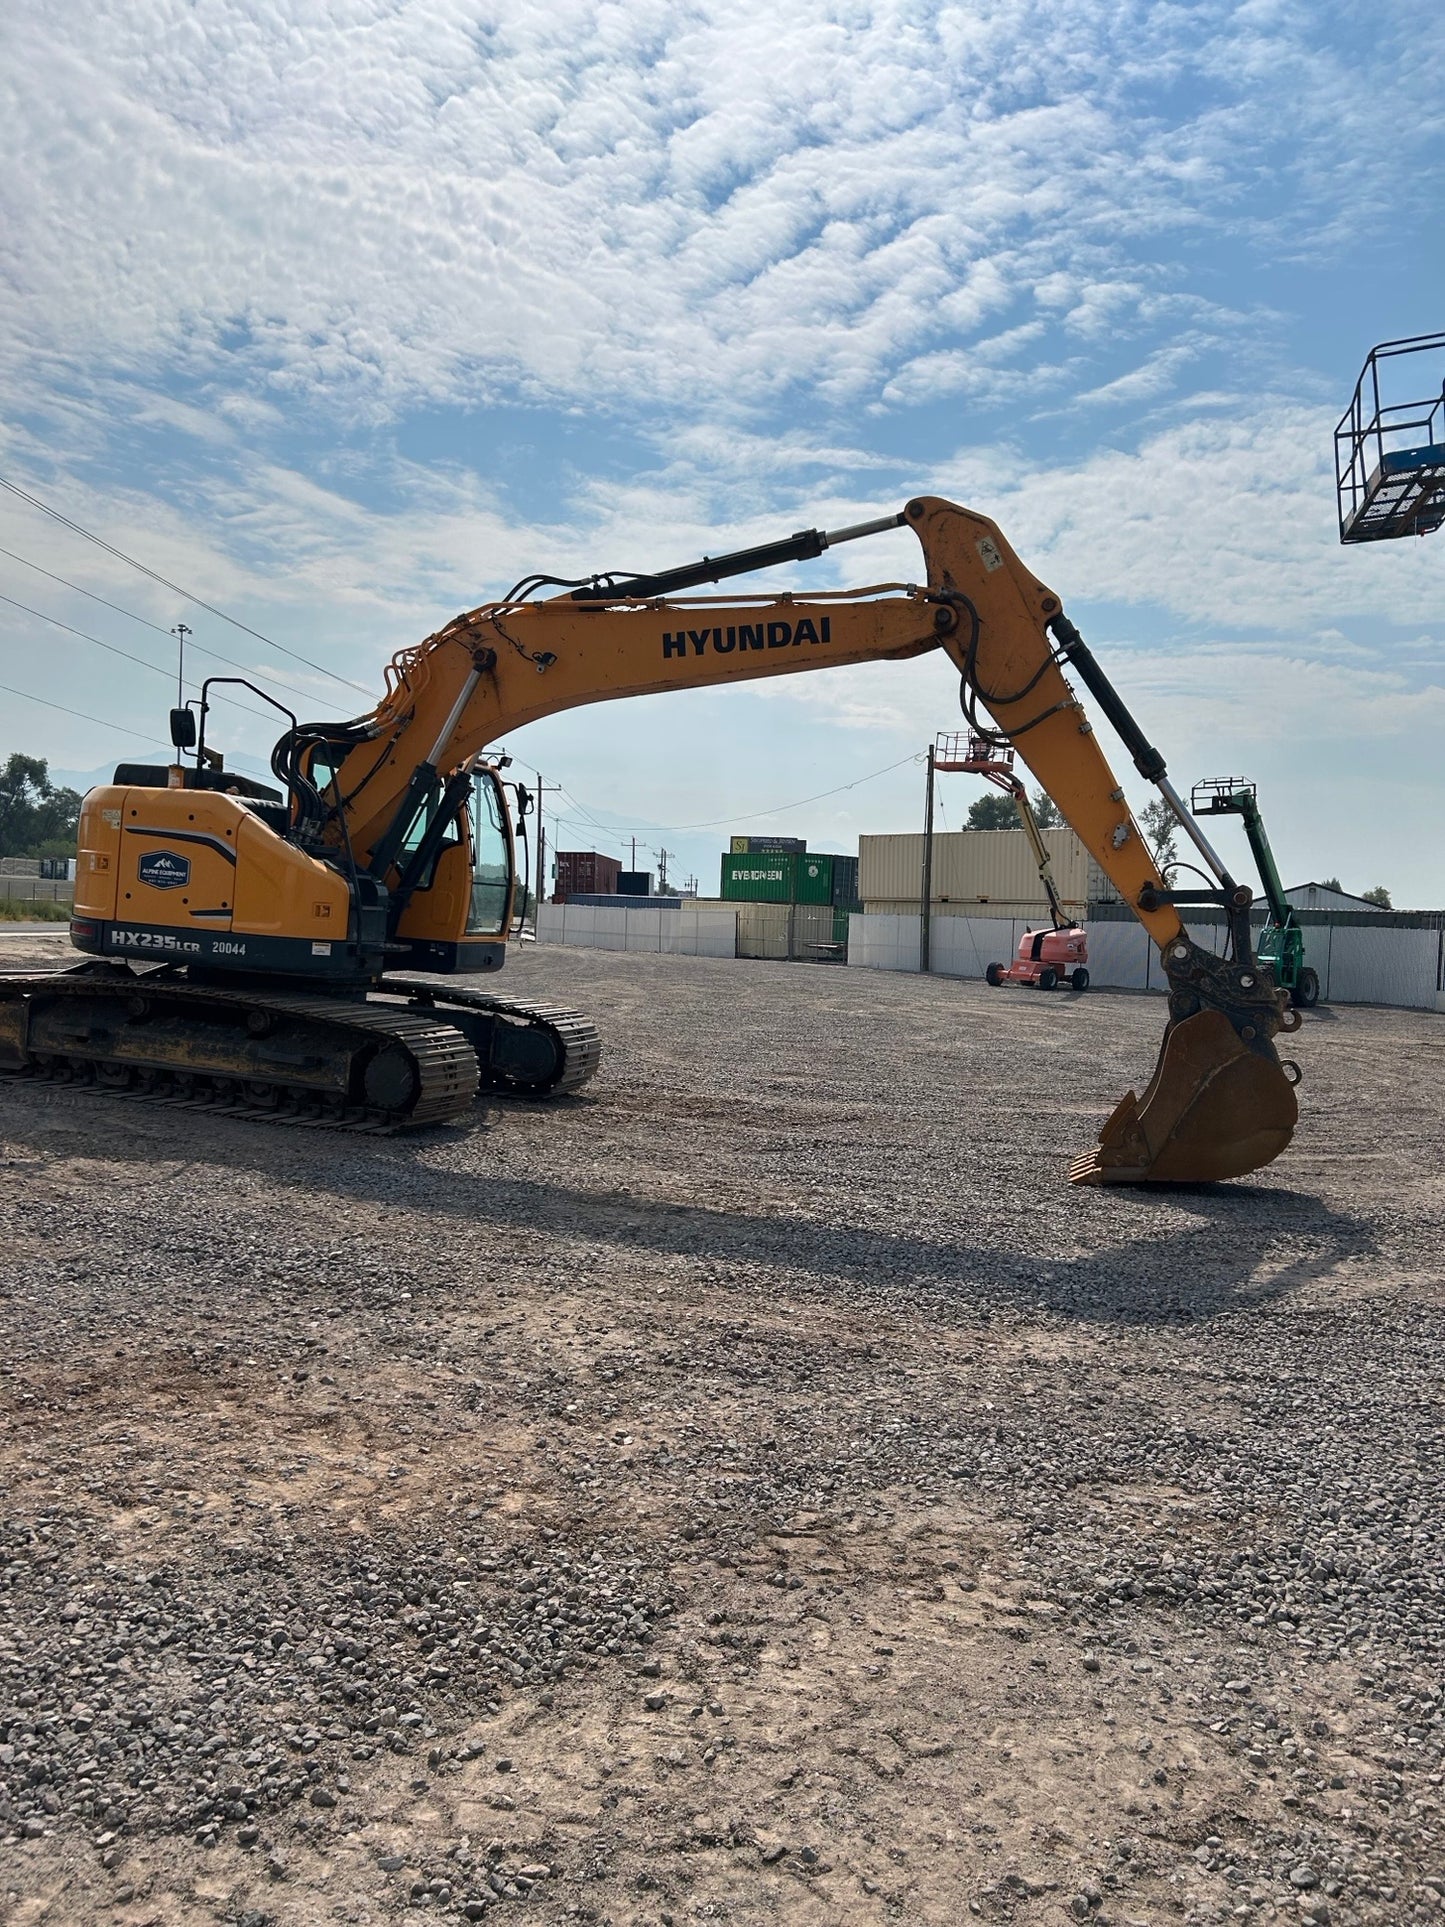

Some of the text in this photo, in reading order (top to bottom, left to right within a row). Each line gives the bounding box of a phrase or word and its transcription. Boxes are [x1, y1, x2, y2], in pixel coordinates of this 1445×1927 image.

[662, 616, 831, 659] HYUNDAI
[160, 870, 187, 878] EQUIPMENT
[732, 870, 783, 880] EVERGREEN
[212, 941, 246, 956] 20044
